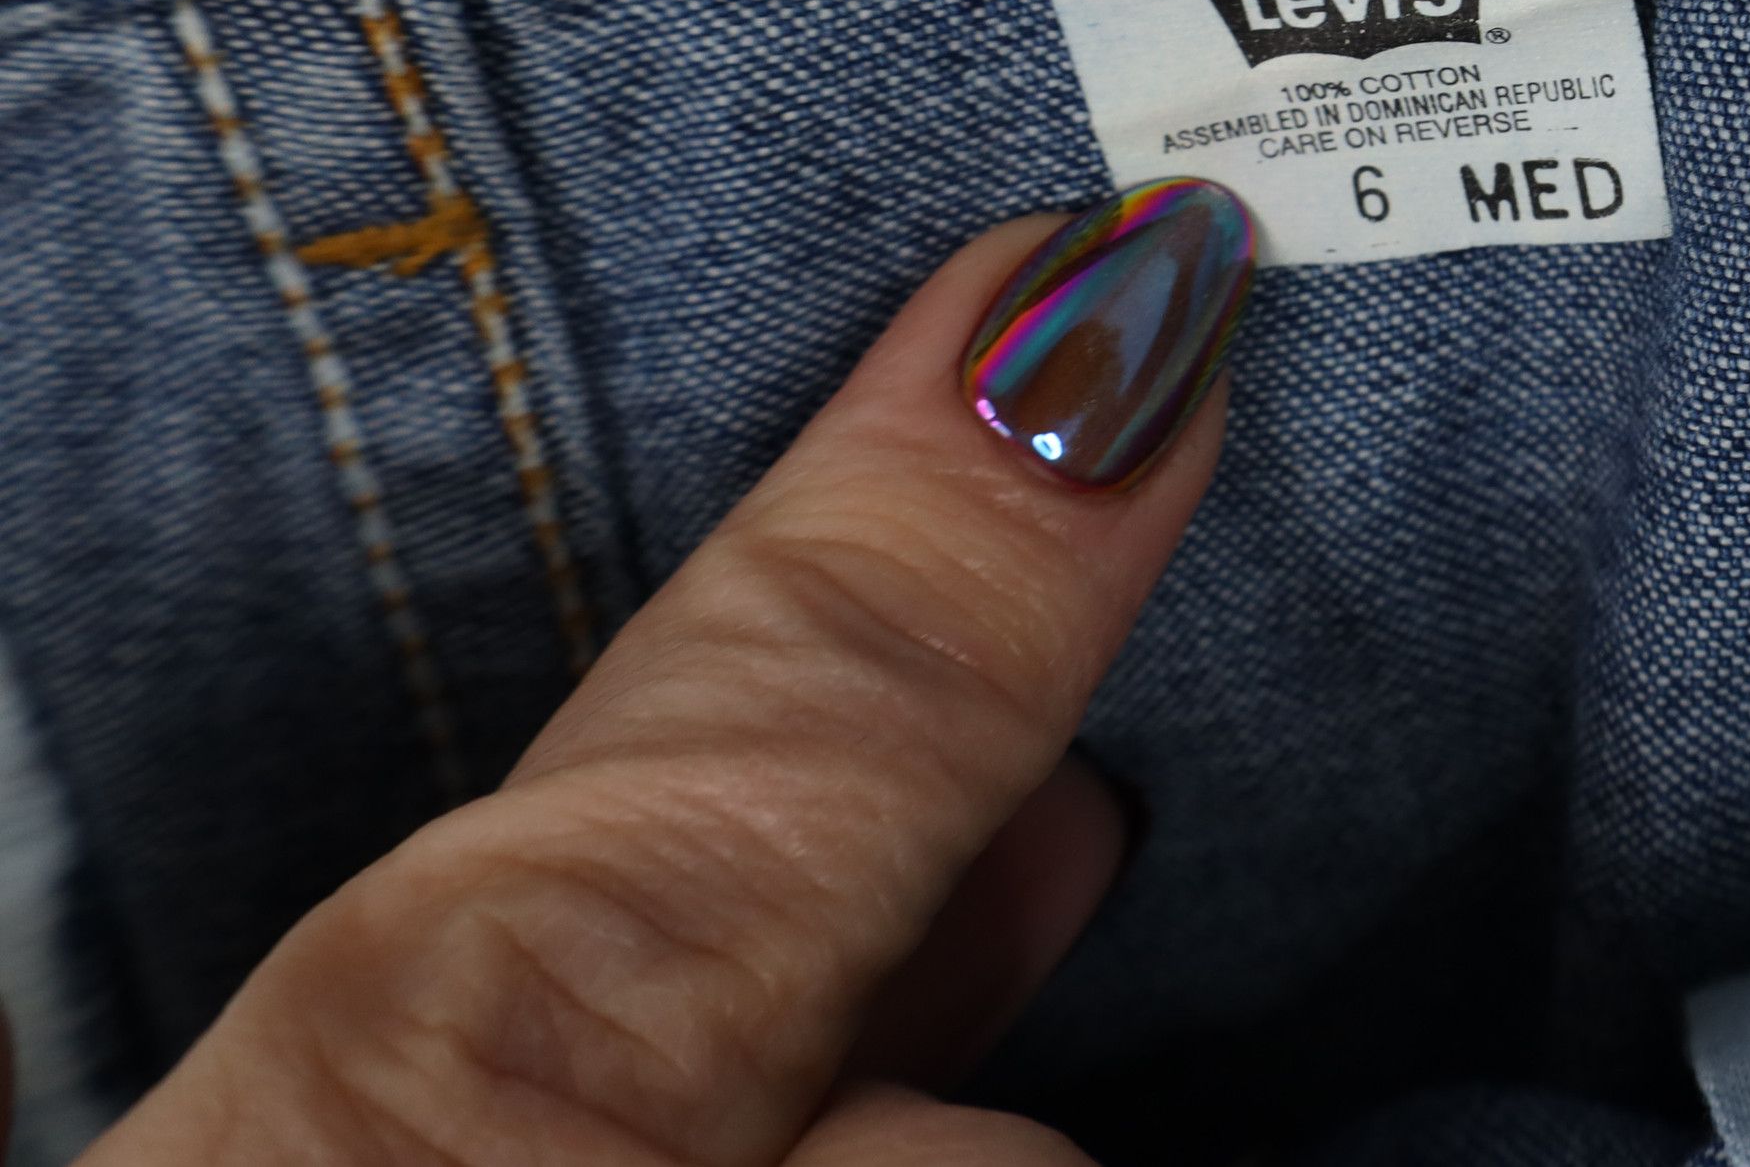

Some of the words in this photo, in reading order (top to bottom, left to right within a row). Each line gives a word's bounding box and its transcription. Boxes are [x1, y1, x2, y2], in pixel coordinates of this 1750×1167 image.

[1281, 83, 1351, 104] 100%
[1359, 64, 1482, 94] COTTON
[1162, 108, 1309, 154] ASSEMBLED
[1315, 105, 1341, 128] IN
[1347, 90, 1488, 122] DOMINICAN
[1495, 73, 1616, 106] REPUBLIC
[1259, 131, 1338, 159] CARE
[1344, 126, 1390, 148] ON
[1397, 111, 1532, 144] REVERSE
[1353, 165, 1390, 222] 6
[1459, 158, 1624, 222] MED
